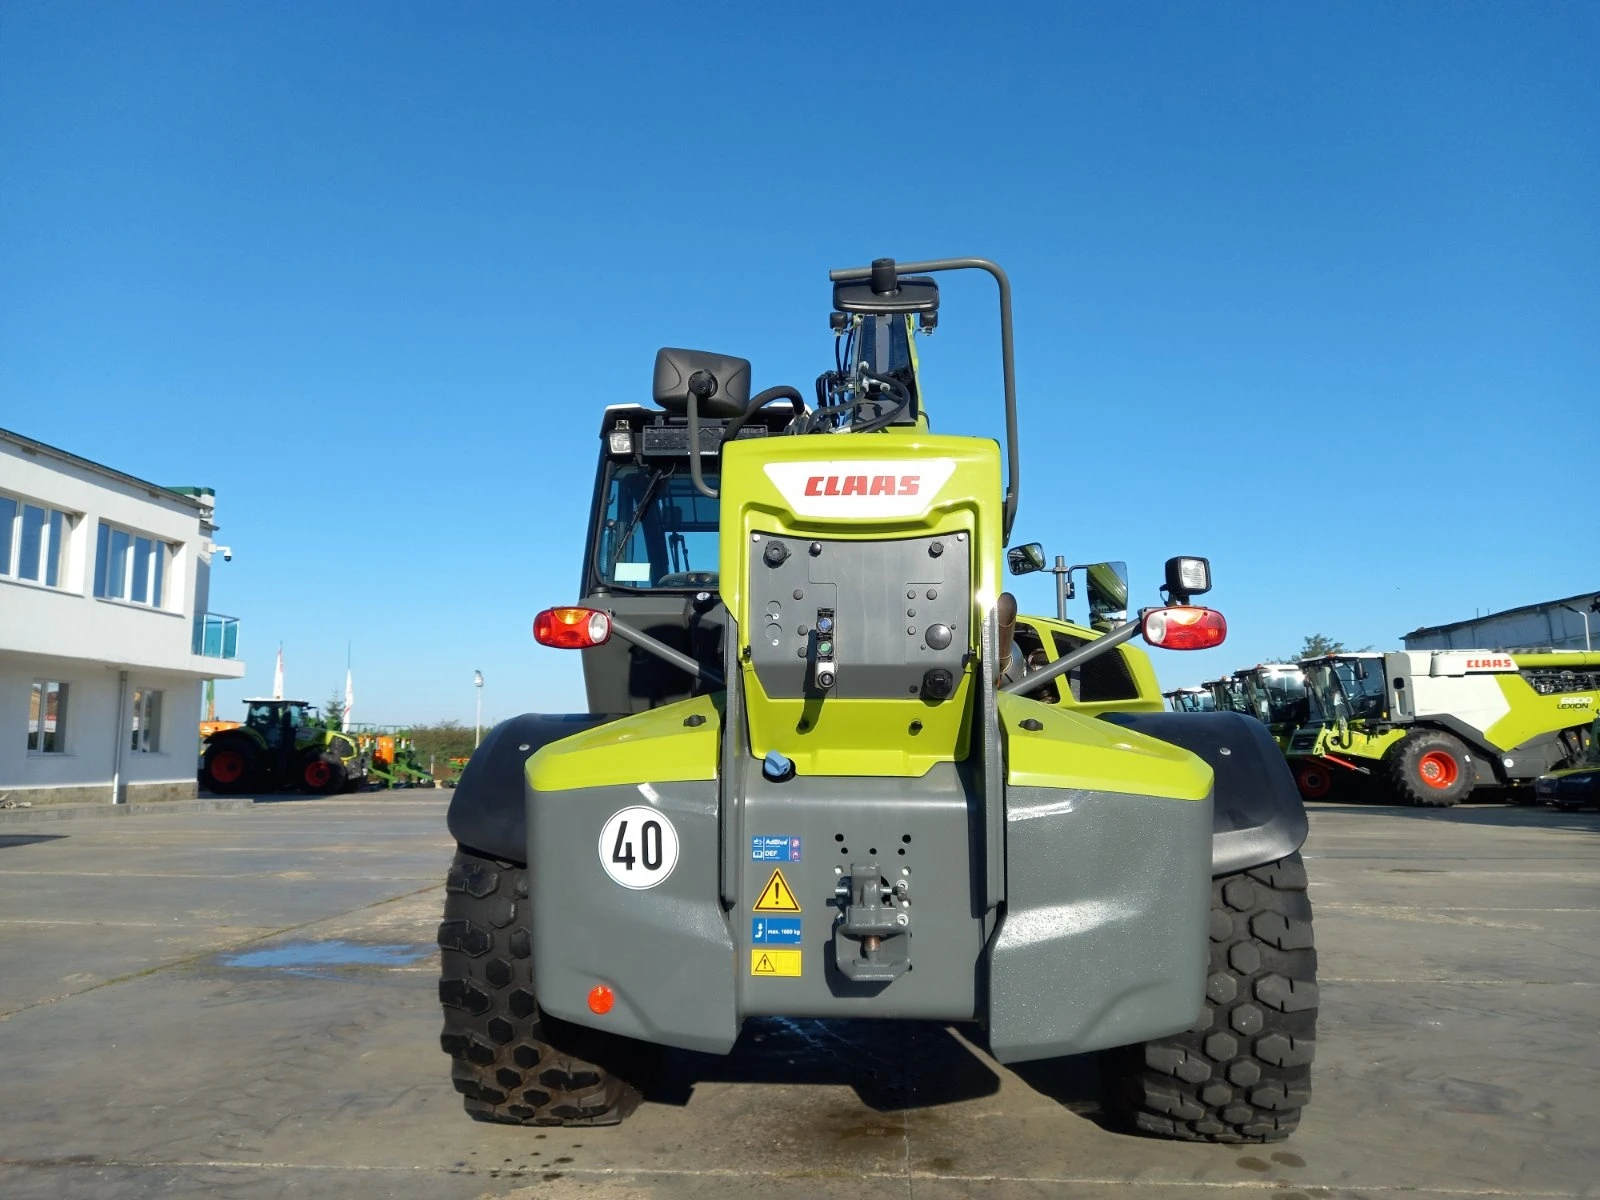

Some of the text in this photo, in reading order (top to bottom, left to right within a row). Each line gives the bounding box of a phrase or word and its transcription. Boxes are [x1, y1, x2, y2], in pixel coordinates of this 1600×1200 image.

[804, 475, 920, 496] CLAAS
[1467, 659, 1512, 668] CLAAS
[612, 820, 663, 871] 40
